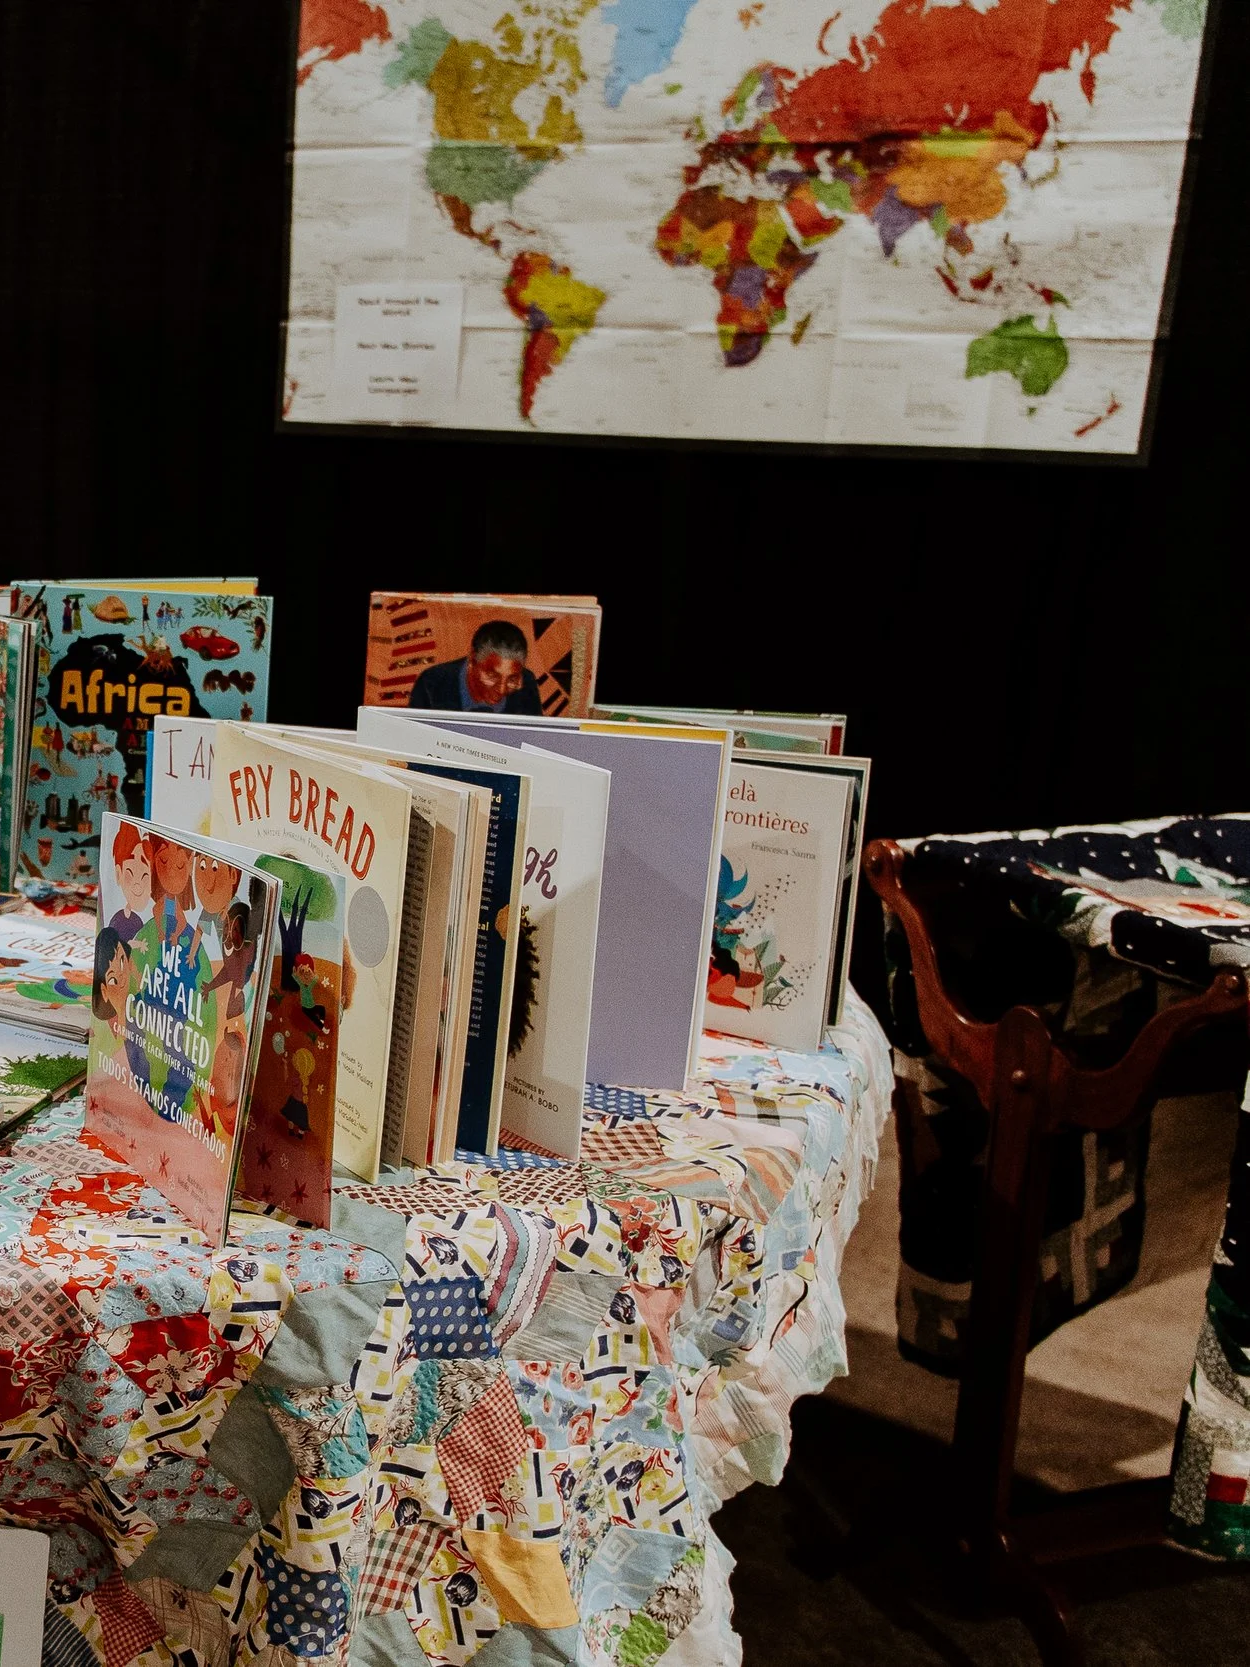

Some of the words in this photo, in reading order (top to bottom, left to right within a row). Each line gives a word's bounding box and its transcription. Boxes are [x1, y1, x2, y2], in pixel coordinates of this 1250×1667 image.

[61, 668, 190, 716] Africa
[162, 729, 182, 779] I
[440, 741, 451, 749] NEW
[452, 743, 466, 754] YORK
[466, 747, 480, 758] TIMES
[480, 751, 508, 765] BESTSELLER
[229, 764, 273, 825] FRY
[289, 768, 375, 880] BREAD
[724, 809, 809, 835] rontières
[750, 842, 789, 856] Francesca
[790, 847, 816, 860] Sanna
[161, 938, 182, 978] WE
[139, 963, 170, 1006] ARE
[173, 981, 204, 1027] ALL
[125, 993, 210, 1069] CONNECTED
[113, 1021, 135, 1044] CARING
[135, 1033, 147, 1050] FOR
[147, 1040, 163, 1060] EACH
[163, 1051, 182, 1073] OTHER
[186, 1065, 196, 1084] THE
[196, 1077, 215, 1097] EARTH
[97, 1050, 128, 1085] TODOS
[127, 1070, 170, 1116] ESTAMOS
[170, 1099, 227, 1165] CONECTADOS
[538, 1097, 559, 1113] BOBO
